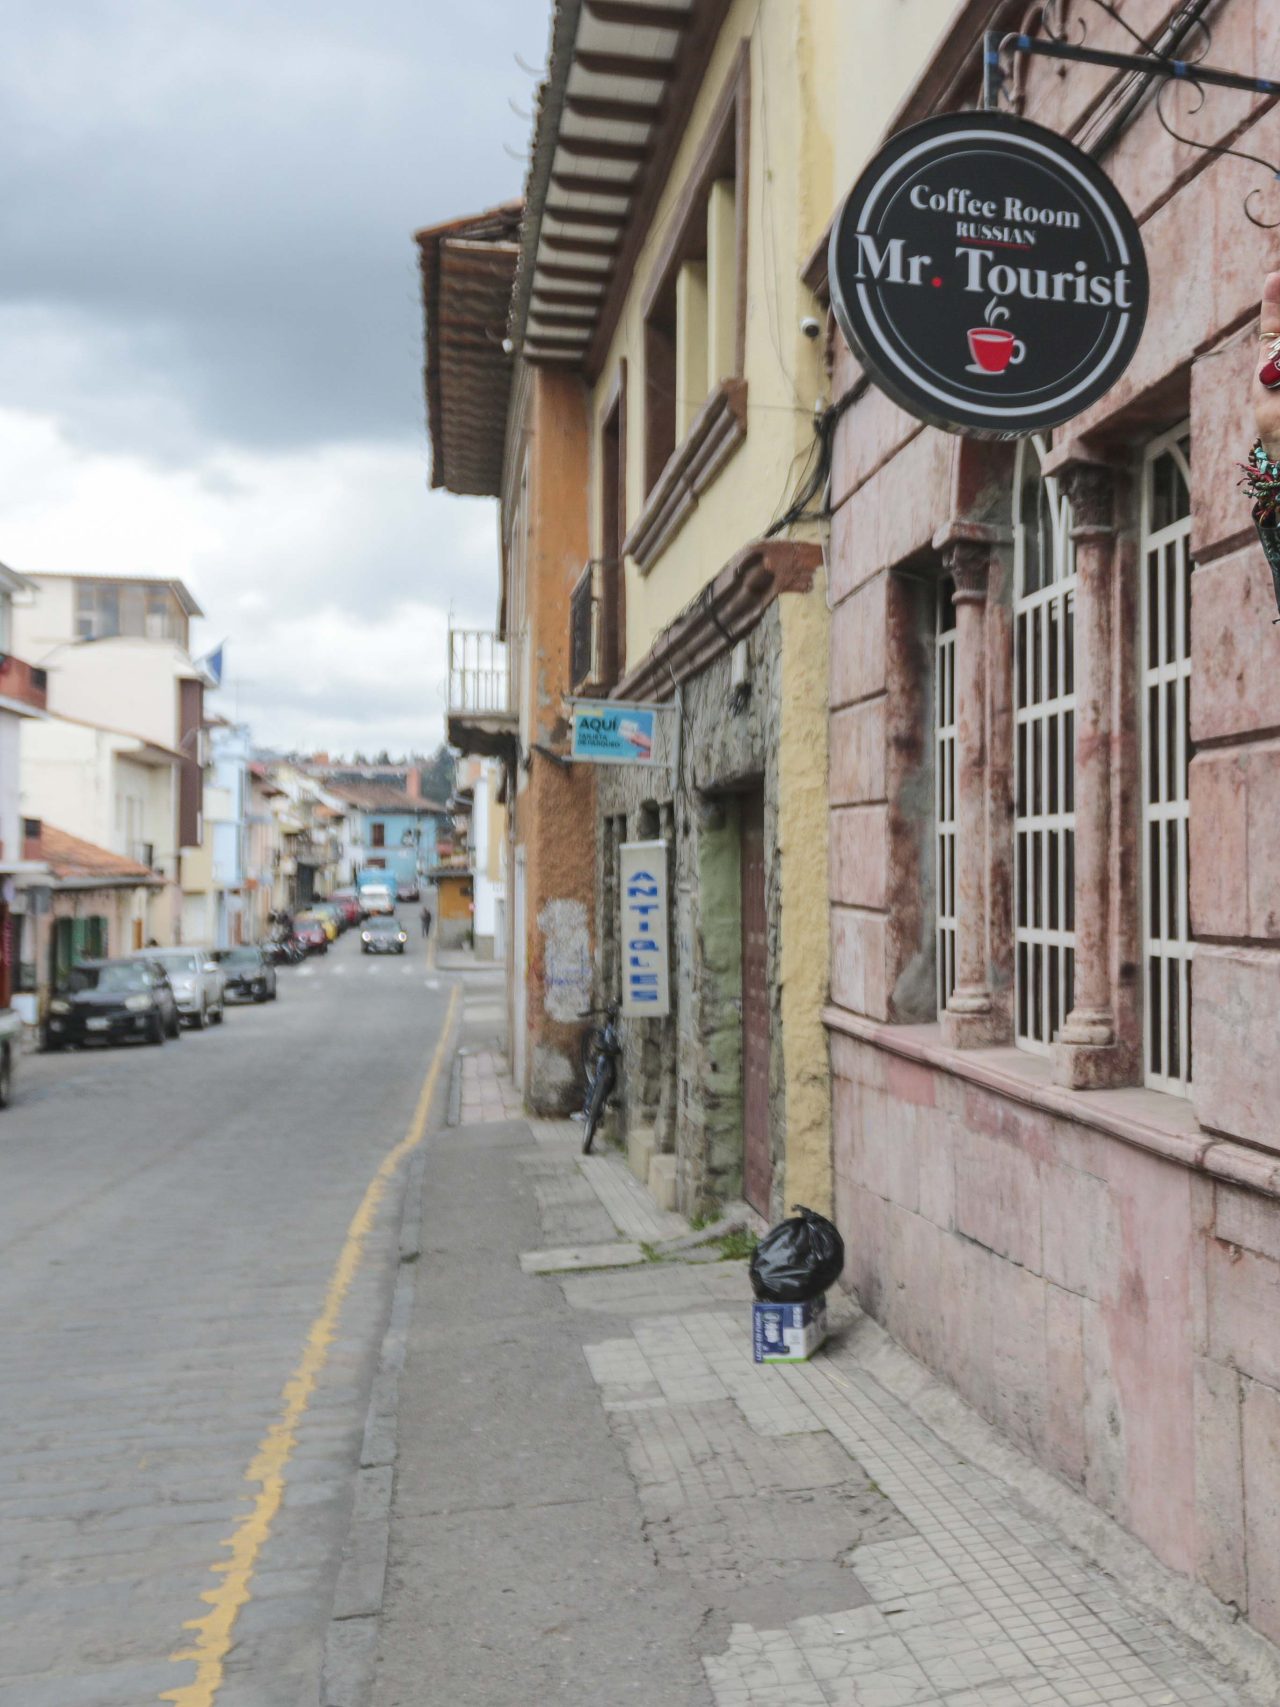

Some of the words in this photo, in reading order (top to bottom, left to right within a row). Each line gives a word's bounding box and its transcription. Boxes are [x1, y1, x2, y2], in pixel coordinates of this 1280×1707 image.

[909, 184, 997, 218] Coffee
[1003, 196, 1081, 229] Room
[956, 220, 1037, 246] RUSSIAN
[853, 233, 943, 288] Mr.
[955, 246, 1133, 309] Tourist
